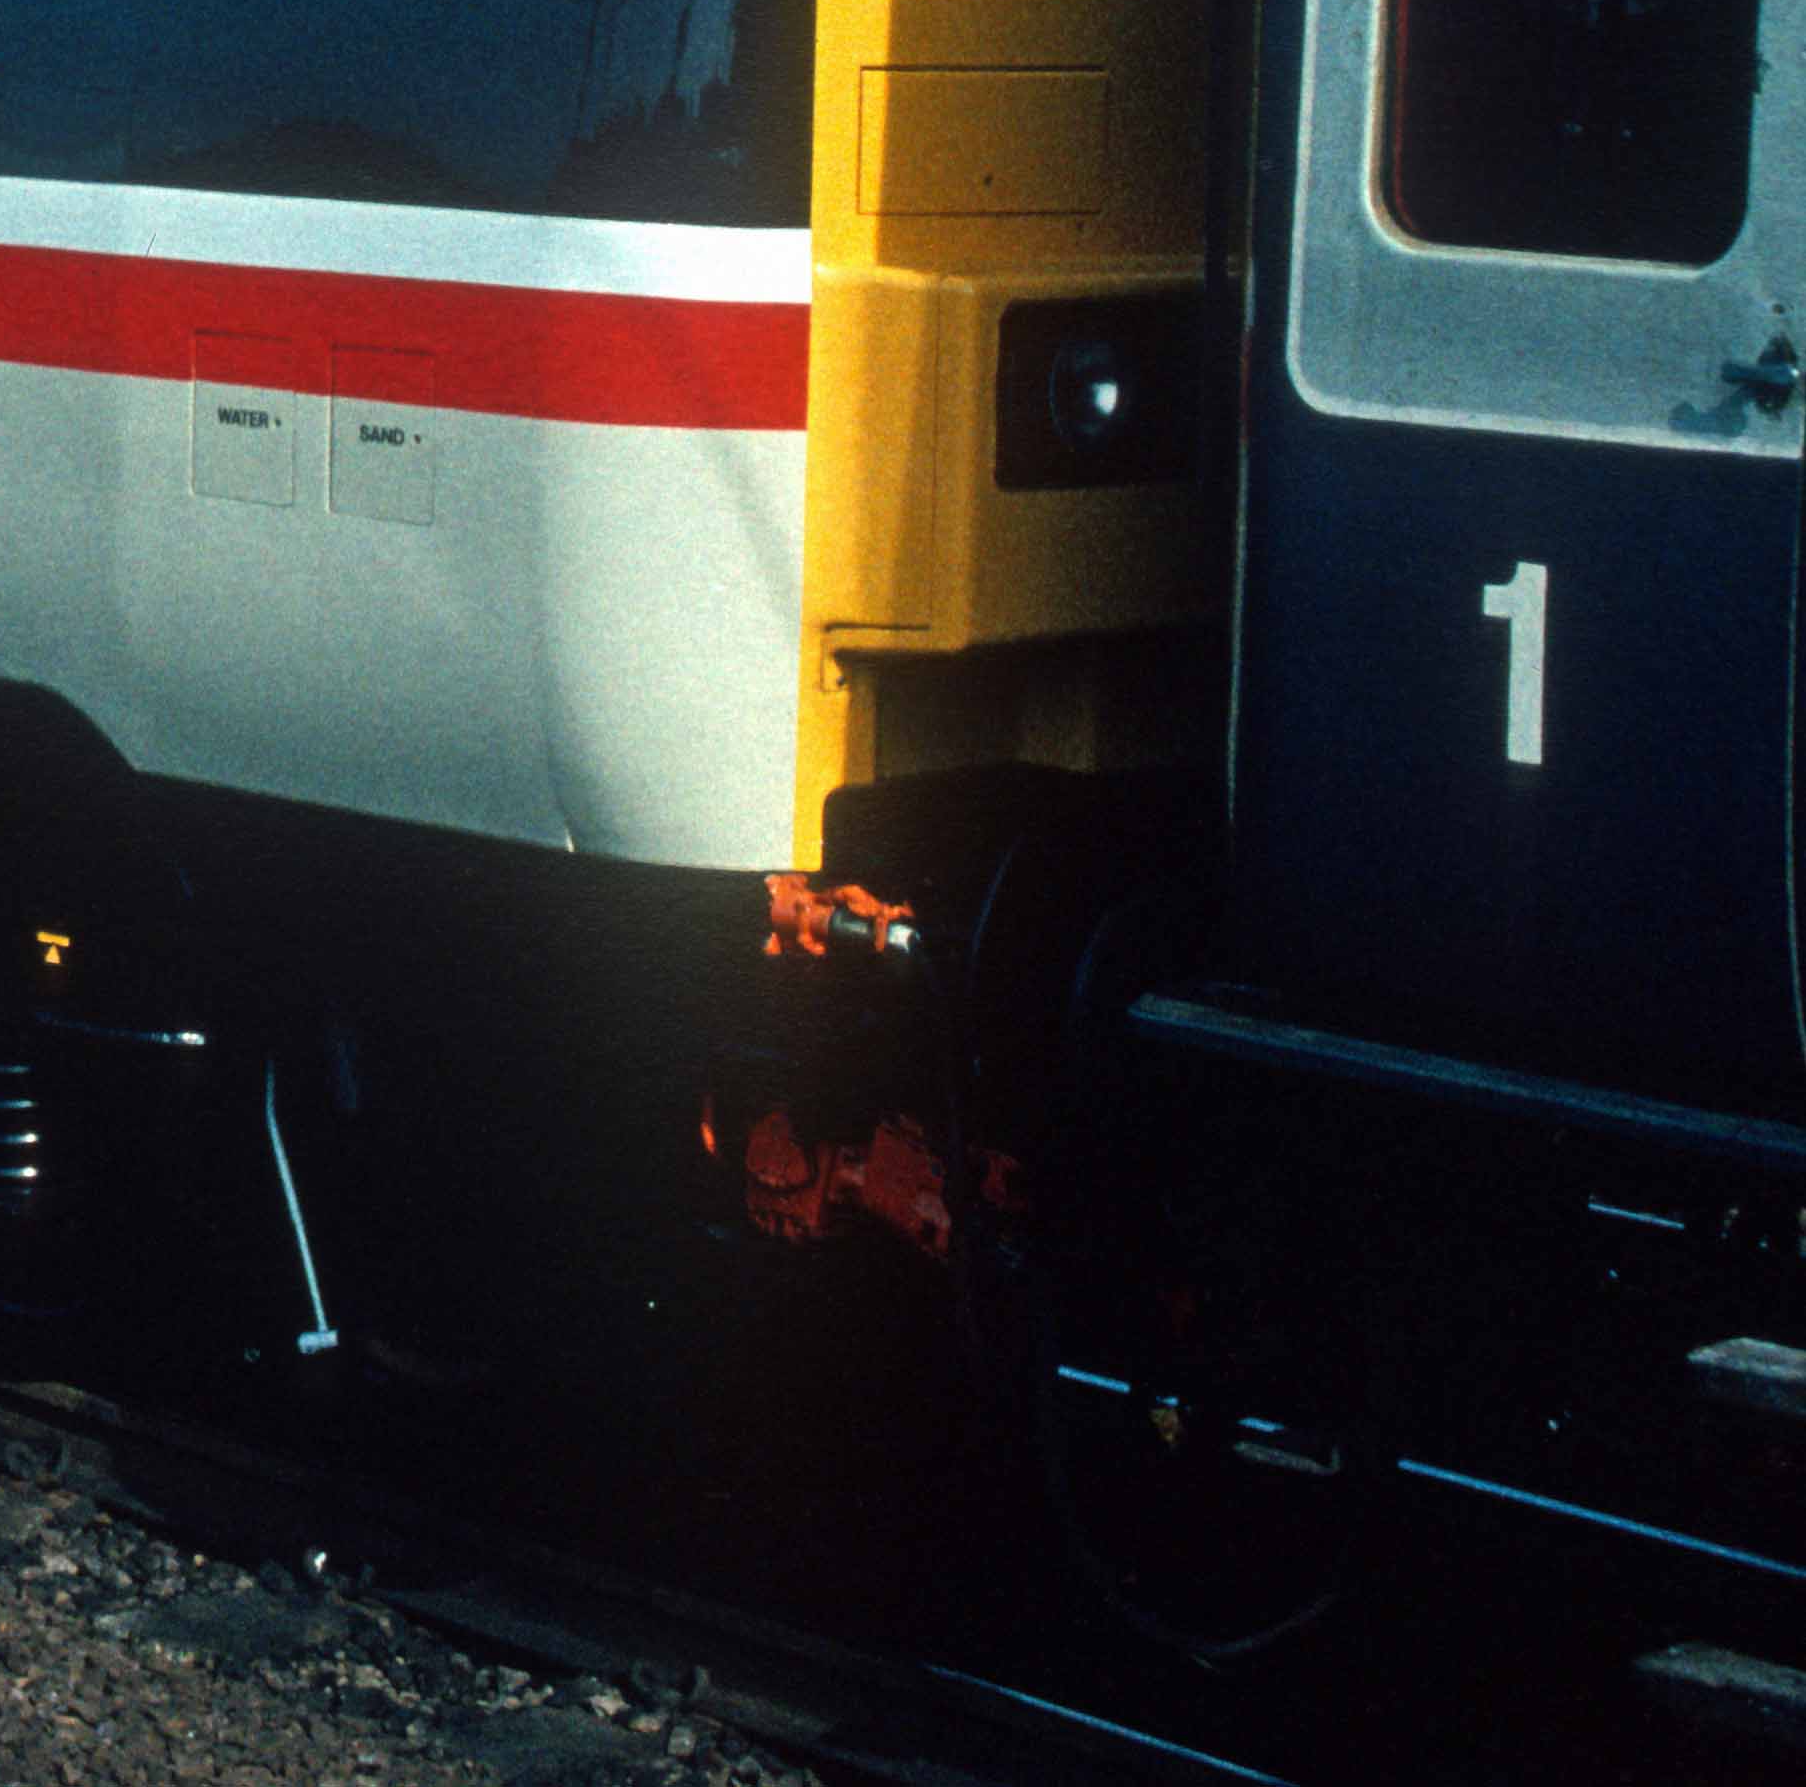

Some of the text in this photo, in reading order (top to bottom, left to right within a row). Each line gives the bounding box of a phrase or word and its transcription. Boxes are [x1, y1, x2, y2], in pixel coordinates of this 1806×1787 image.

[217, 406, 269, 429] WATER
[359, 424, 405, 446] SAND
[1482, 560, 1548, 766] 1
